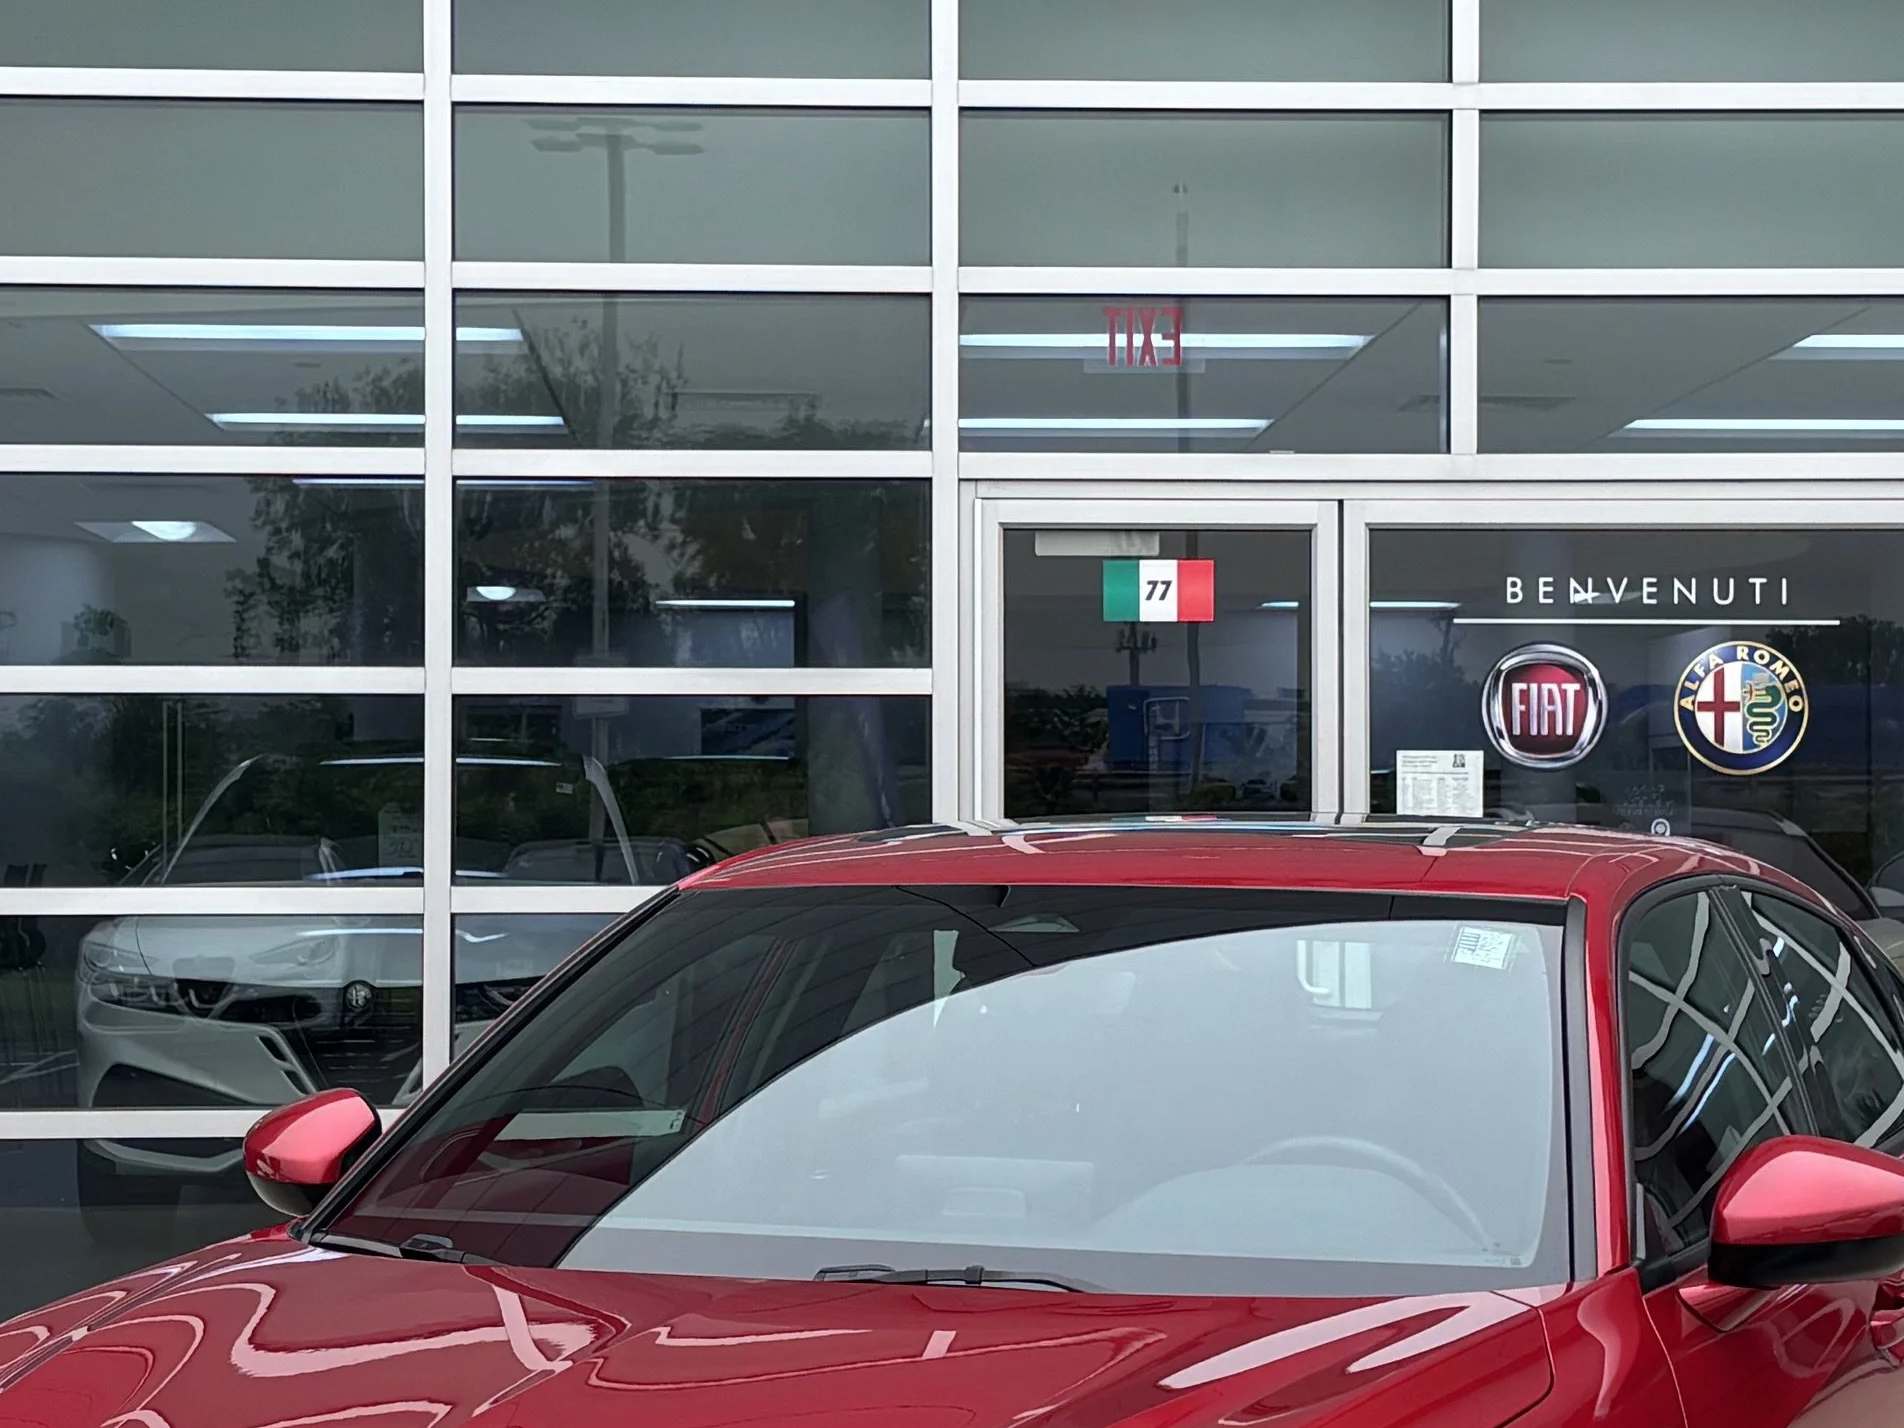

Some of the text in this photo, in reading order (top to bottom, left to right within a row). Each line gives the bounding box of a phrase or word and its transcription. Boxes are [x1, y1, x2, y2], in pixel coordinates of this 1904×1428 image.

[1145, 580, 1173, 601] 77
[1507, 576, 1790, 606] BENVENUTI
[1680, 645, 1803, 712] ALFA ROMEO
[1512, 683, 1580, 735] FIAT
